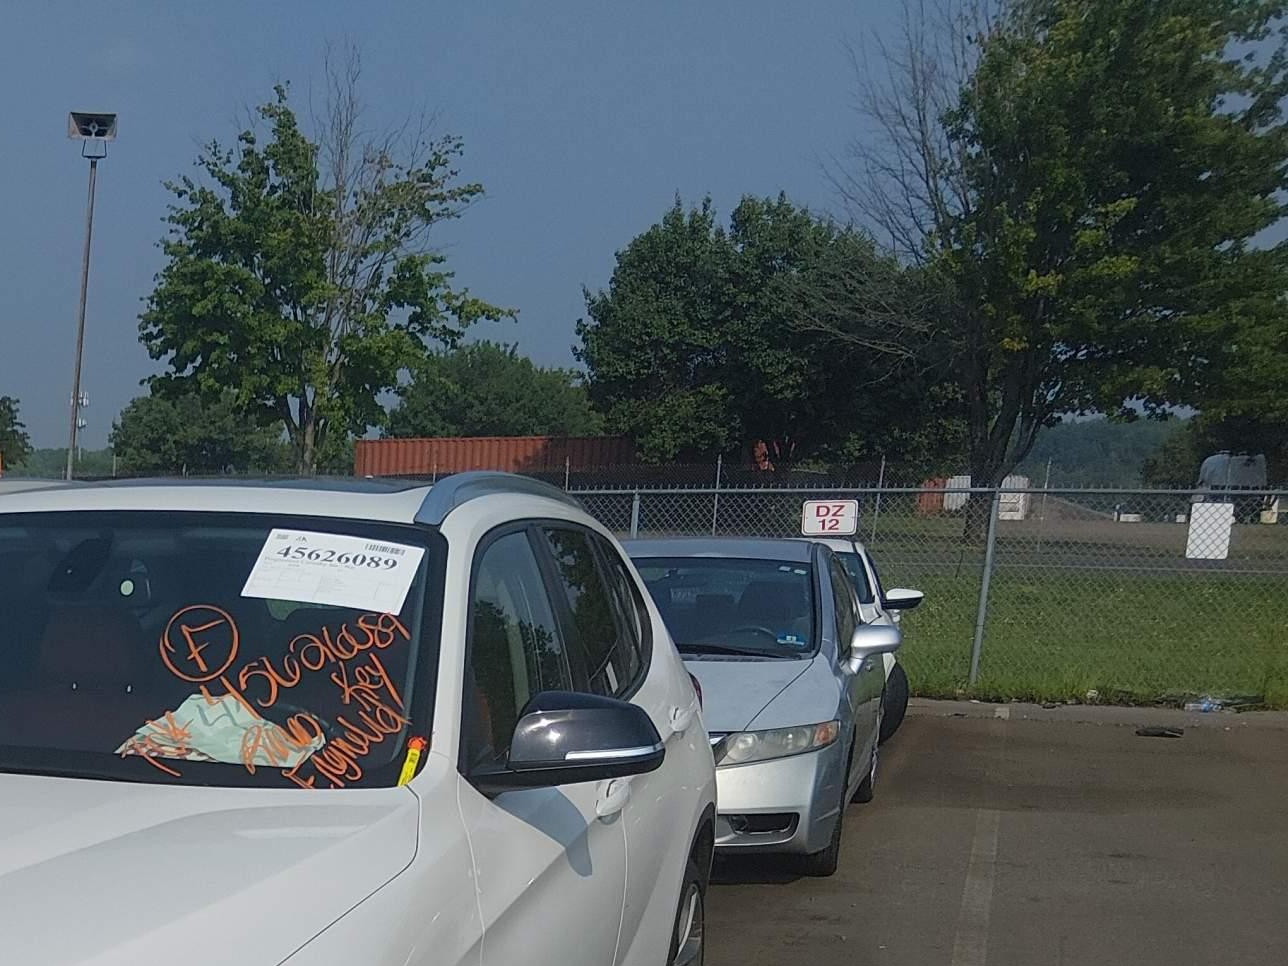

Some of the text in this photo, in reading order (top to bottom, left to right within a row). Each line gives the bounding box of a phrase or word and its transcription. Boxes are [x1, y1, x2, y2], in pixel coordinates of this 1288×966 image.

[816, 505, 845, 517] DZ
[818, 519, 839, 530] 12
[277, 545, 398, 571] 45626089
